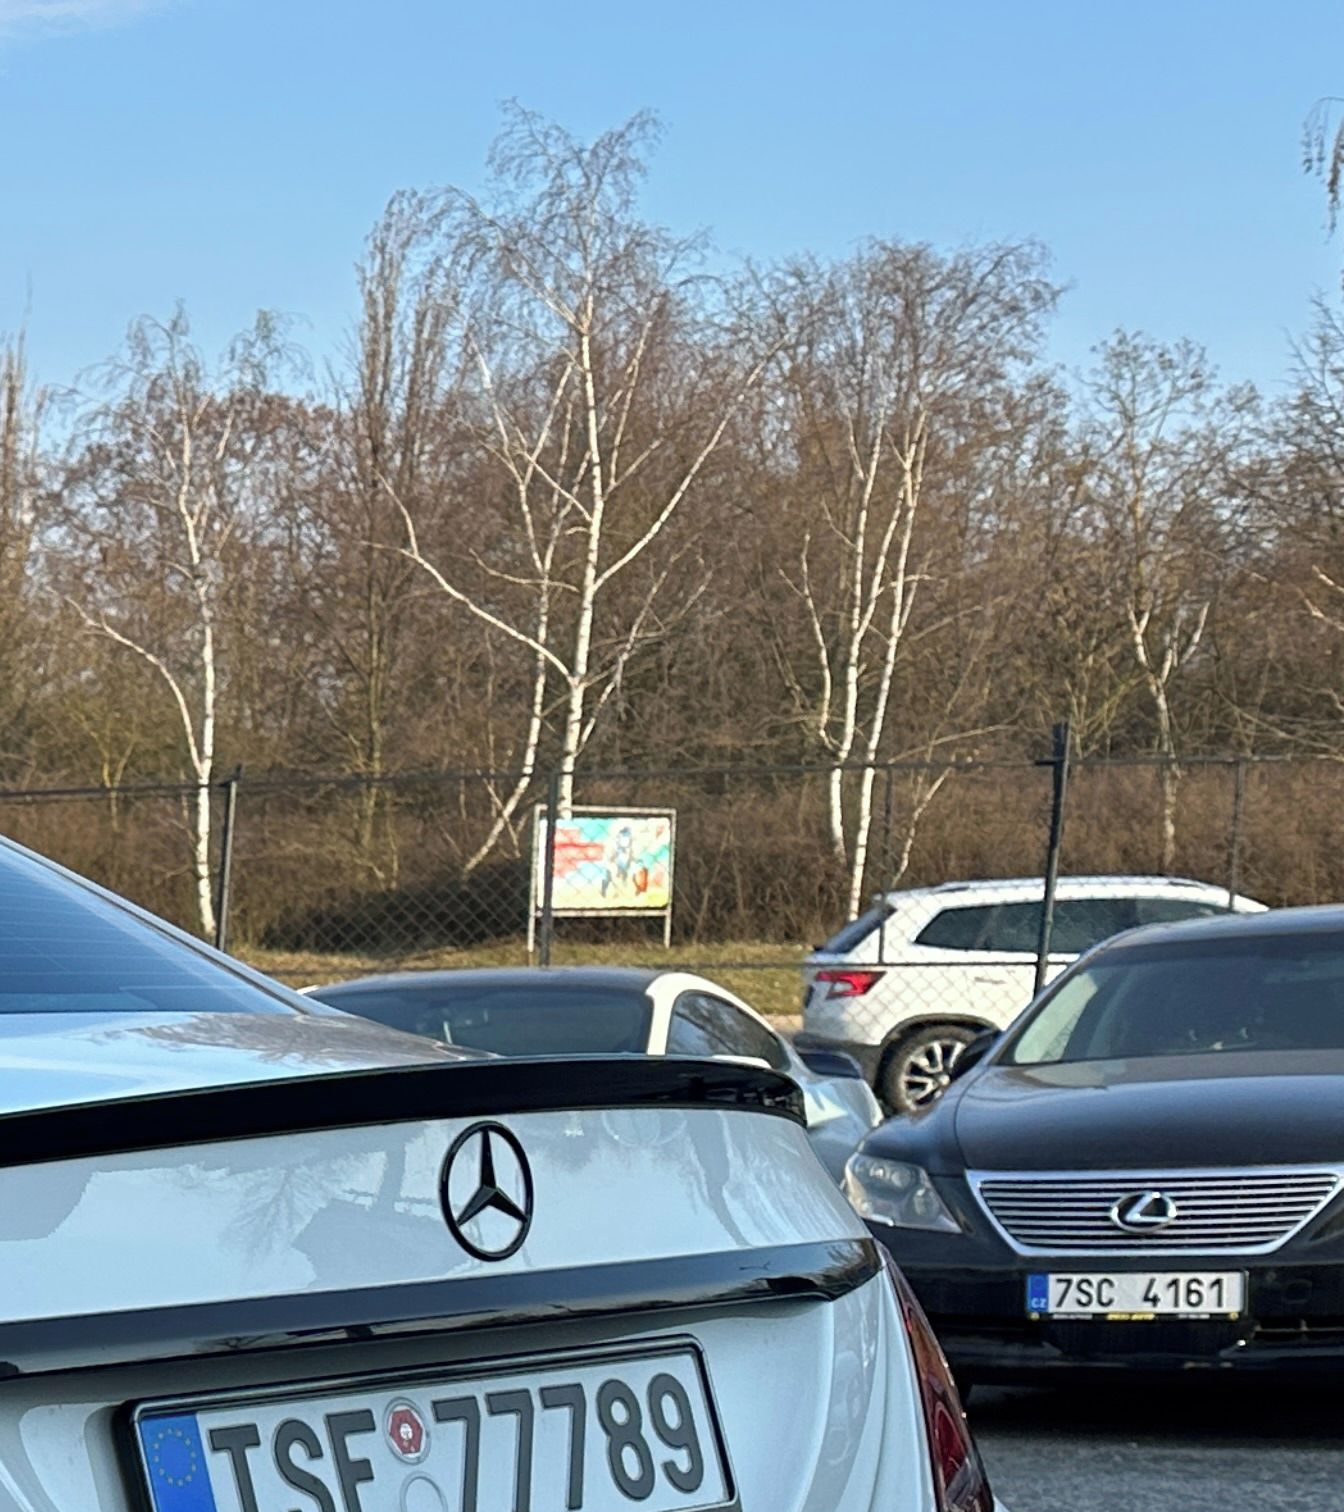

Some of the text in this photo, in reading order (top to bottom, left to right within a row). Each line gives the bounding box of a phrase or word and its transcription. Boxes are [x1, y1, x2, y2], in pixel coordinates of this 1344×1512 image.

[1031, 1297, 1047, 1309] CZ
[1055, 1278, 1226, 1309] 7SC 4161
